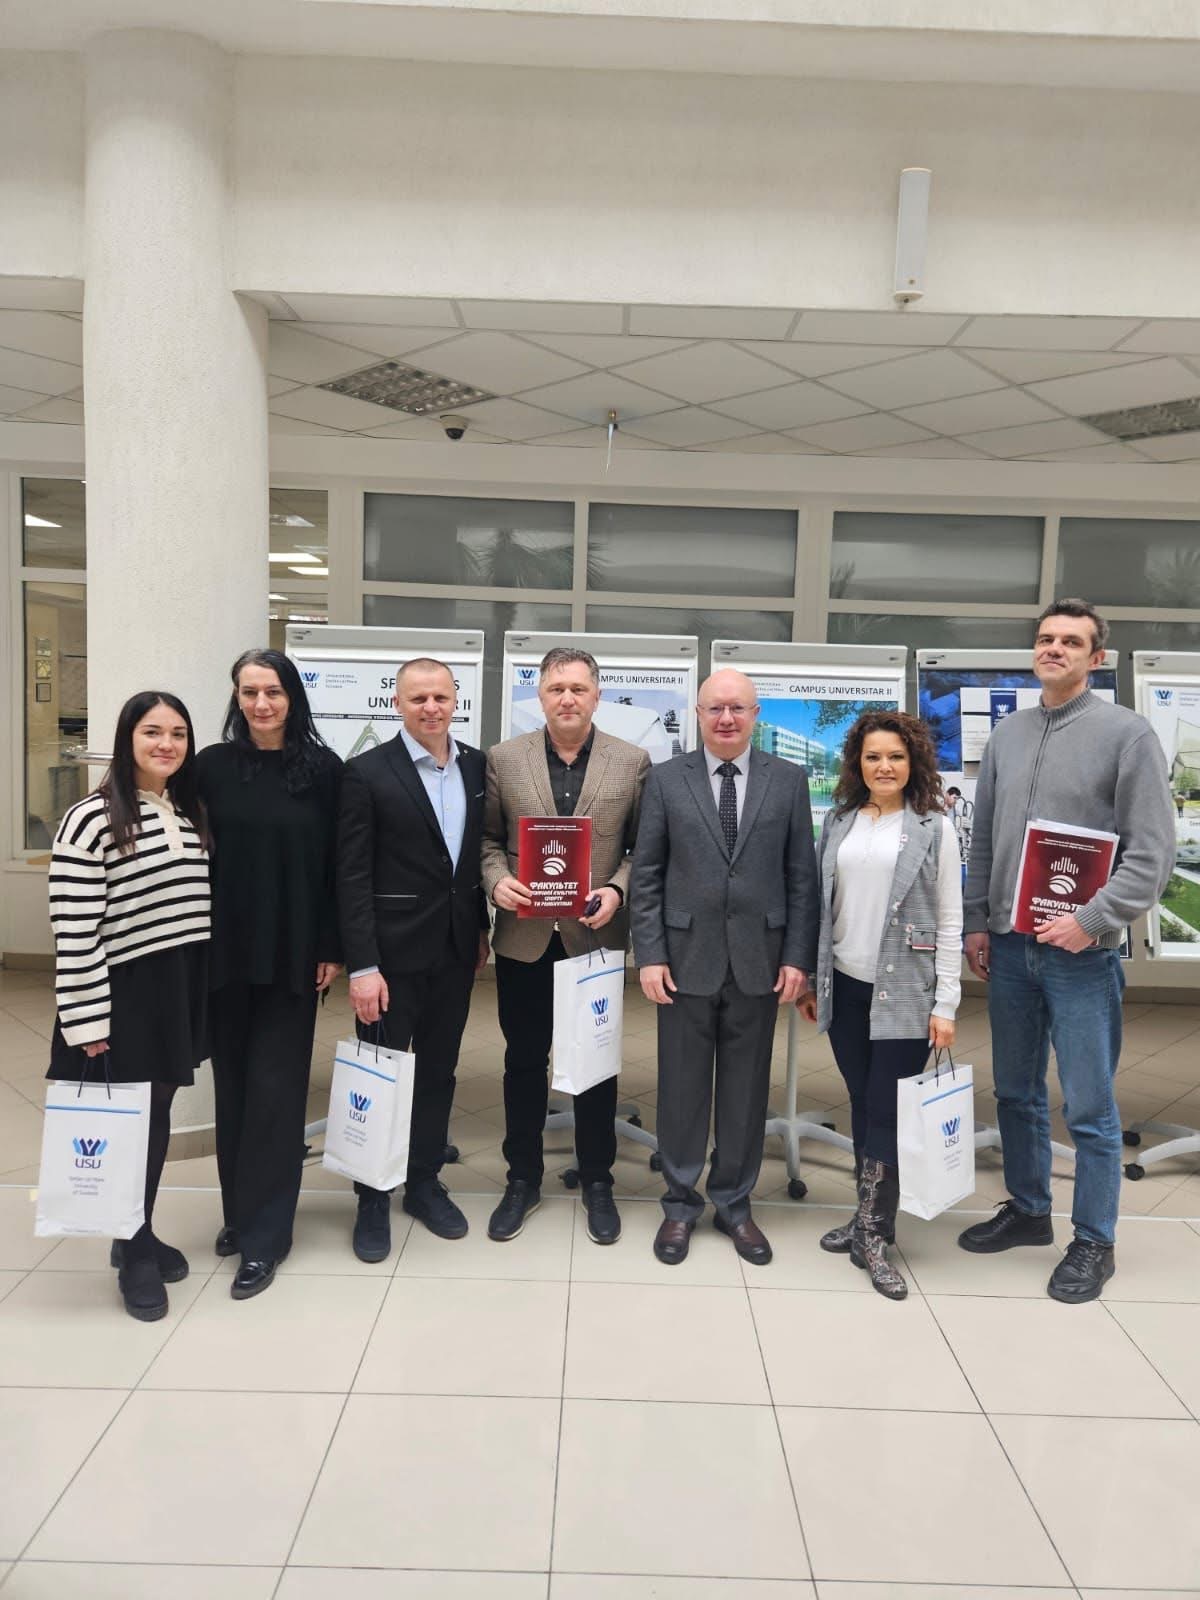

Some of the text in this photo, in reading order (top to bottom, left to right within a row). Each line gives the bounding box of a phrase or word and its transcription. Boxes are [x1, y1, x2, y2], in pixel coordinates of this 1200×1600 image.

[598, 674, 684, 685] MPUS UNIVERSITAR II
[789, 685, 826, 694] CAMPUS
[828, 686, 884, 696] UNIVERSITAR
[886, 687, 892, 696] II
[529, 881, 579, 890] ФАКУЛЬТЕТ
[594, 1015, 609, 1027] USU
[349, 1109, 367, 1123] USU
[944, 1135, 960, 1148] USU
[75, 1158, 101, 1169] USU
